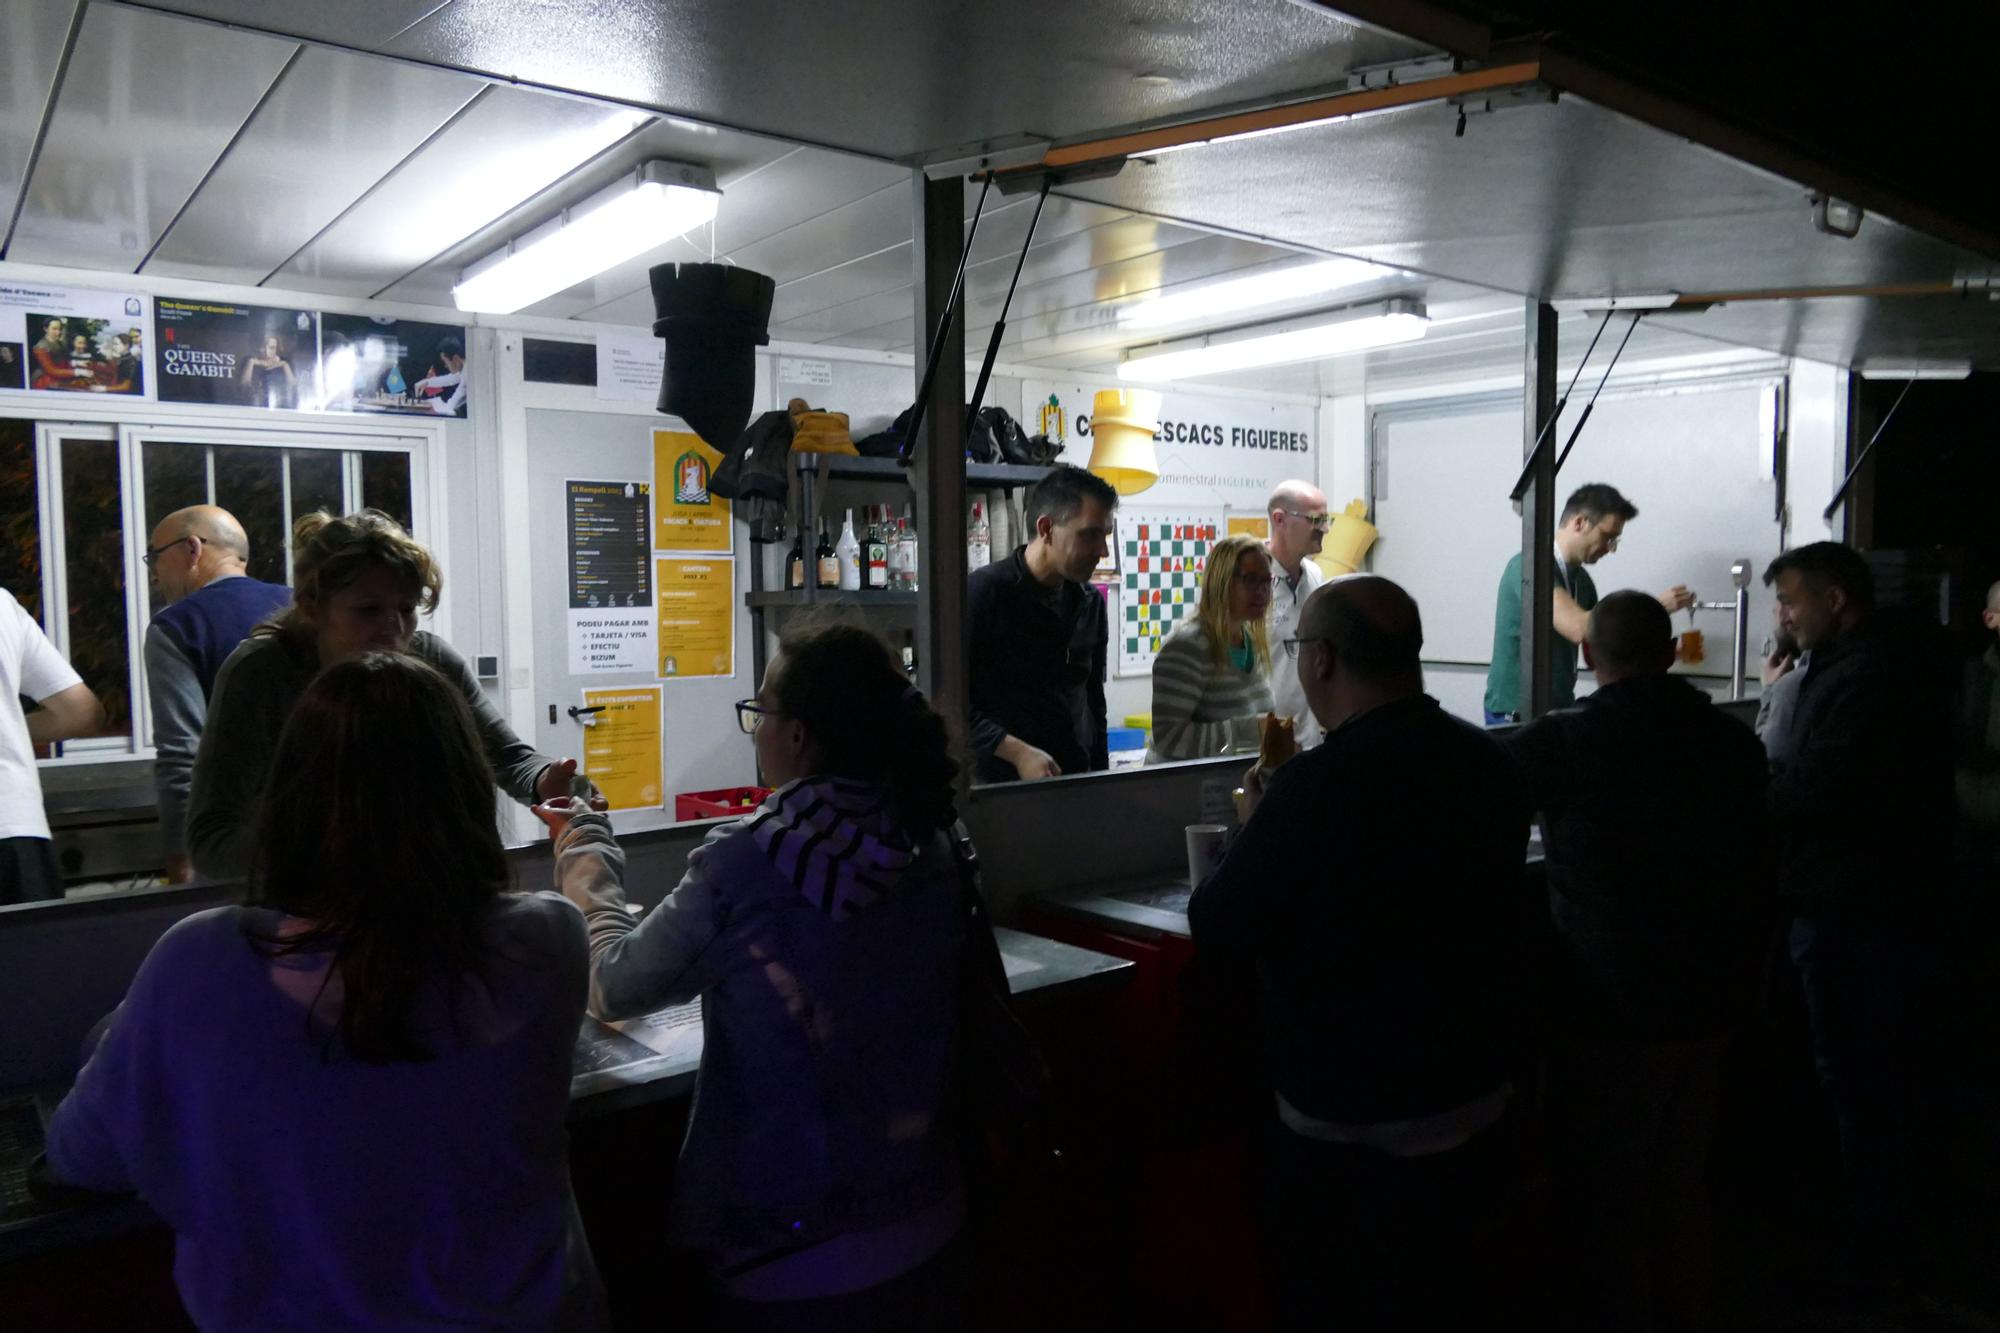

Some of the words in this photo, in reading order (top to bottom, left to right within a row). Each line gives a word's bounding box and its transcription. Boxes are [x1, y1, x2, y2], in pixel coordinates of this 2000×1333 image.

[165, 349, 236, 366] QUEEN'S
[165, 362, 236, 378] GAMBIT
[1231, 427, 1308, 453] FIGUERES
